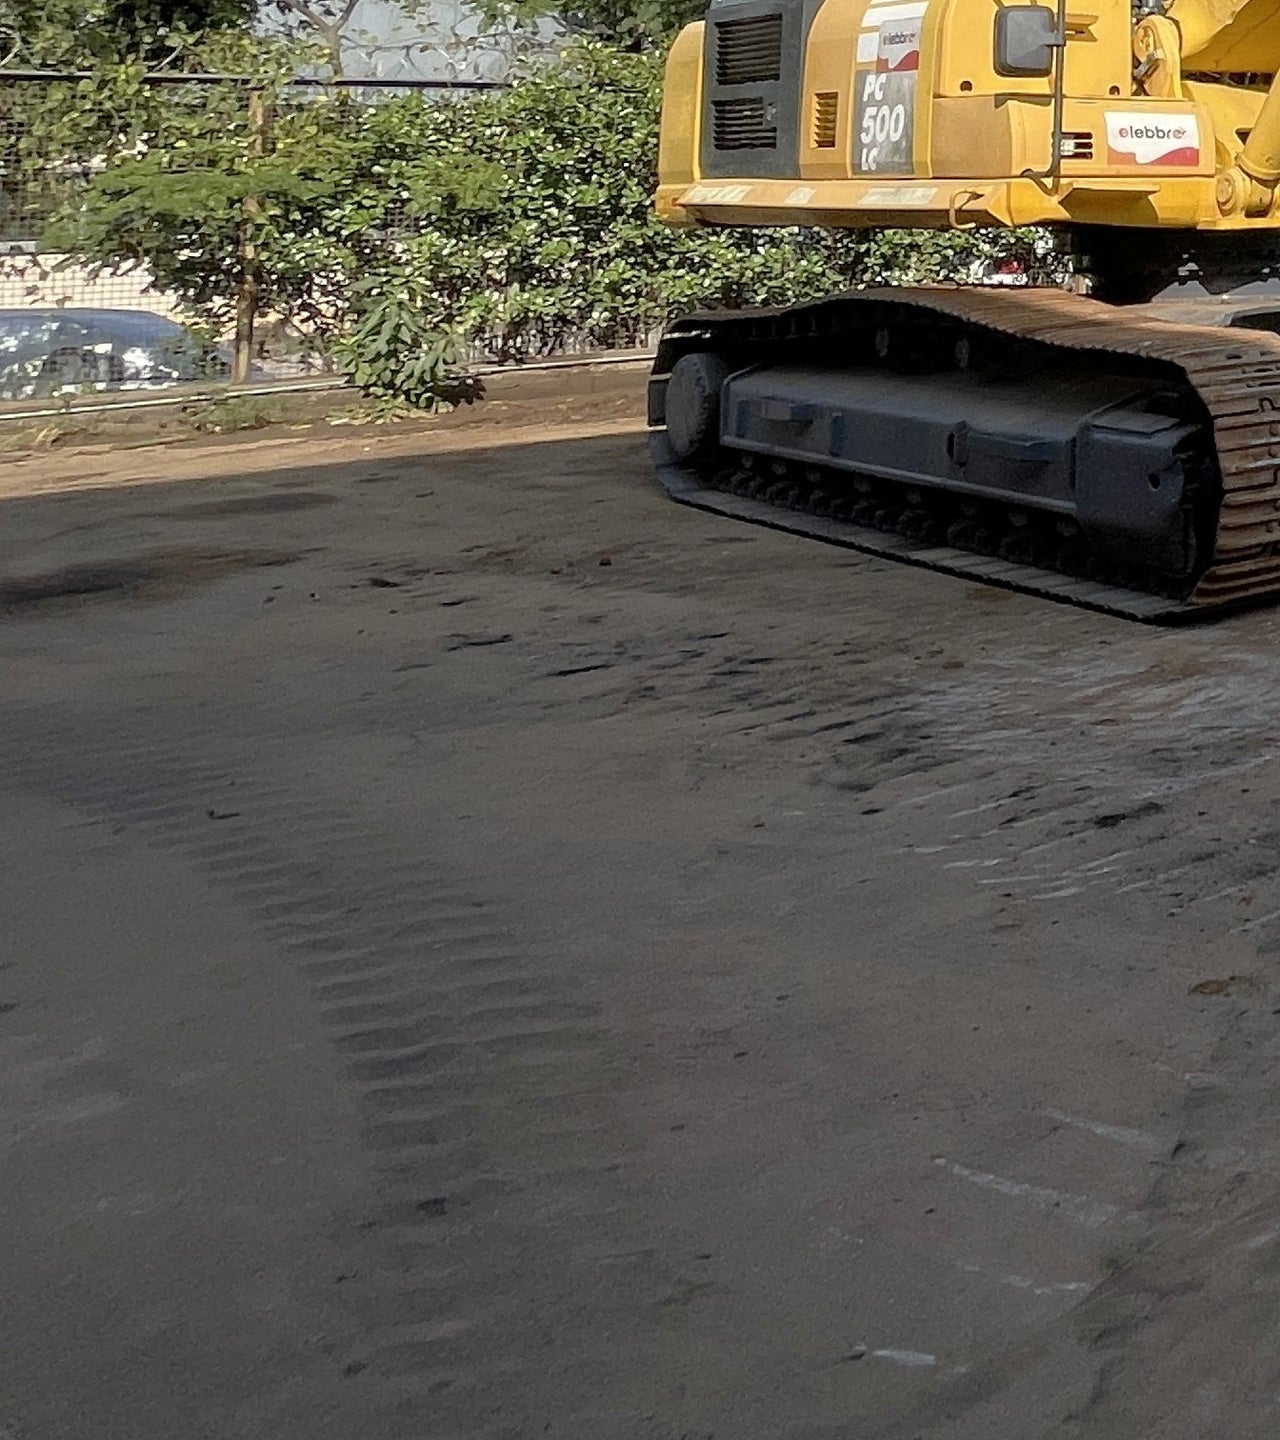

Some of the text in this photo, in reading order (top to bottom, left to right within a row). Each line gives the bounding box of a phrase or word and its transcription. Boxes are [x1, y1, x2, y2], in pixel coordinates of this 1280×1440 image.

[863, 73, 887, 102] PC
[860, 104, 905, 144] 500
[861, 147, 879, 171] LC
